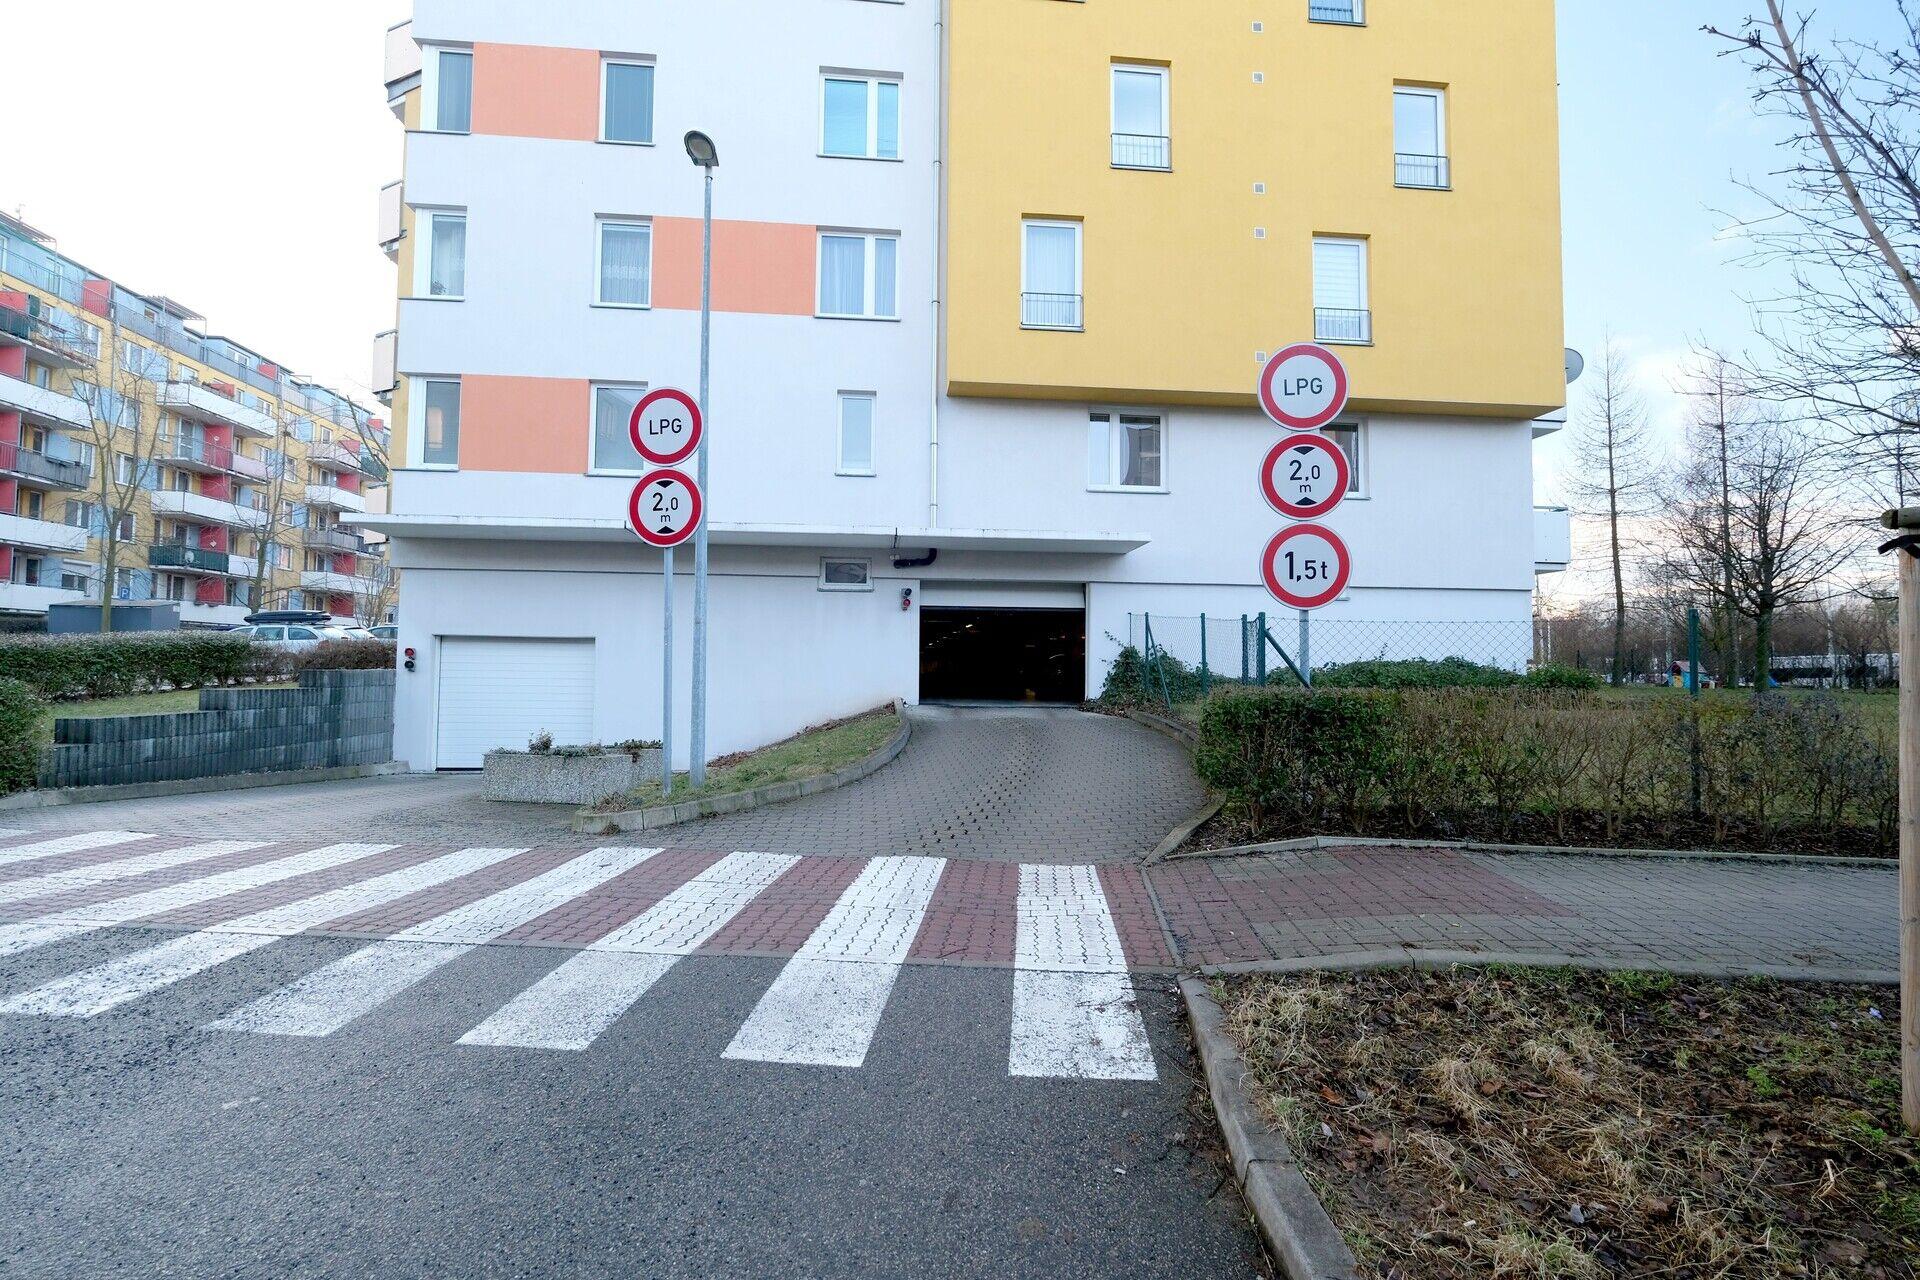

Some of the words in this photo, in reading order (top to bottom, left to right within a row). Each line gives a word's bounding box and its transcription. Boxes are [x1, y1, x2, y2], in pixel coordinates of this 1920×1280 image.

[1284, 377, 1323, 396] LPG
[649, 418, 682, 435] LPG
[1289, 459, 1321, 482] 2,0
[1299, 484, 1312, 493] m
[652, 492, 679, 512] 2,0
[660, 514, 671, 523] m
[121, 588, 129, 598] P
